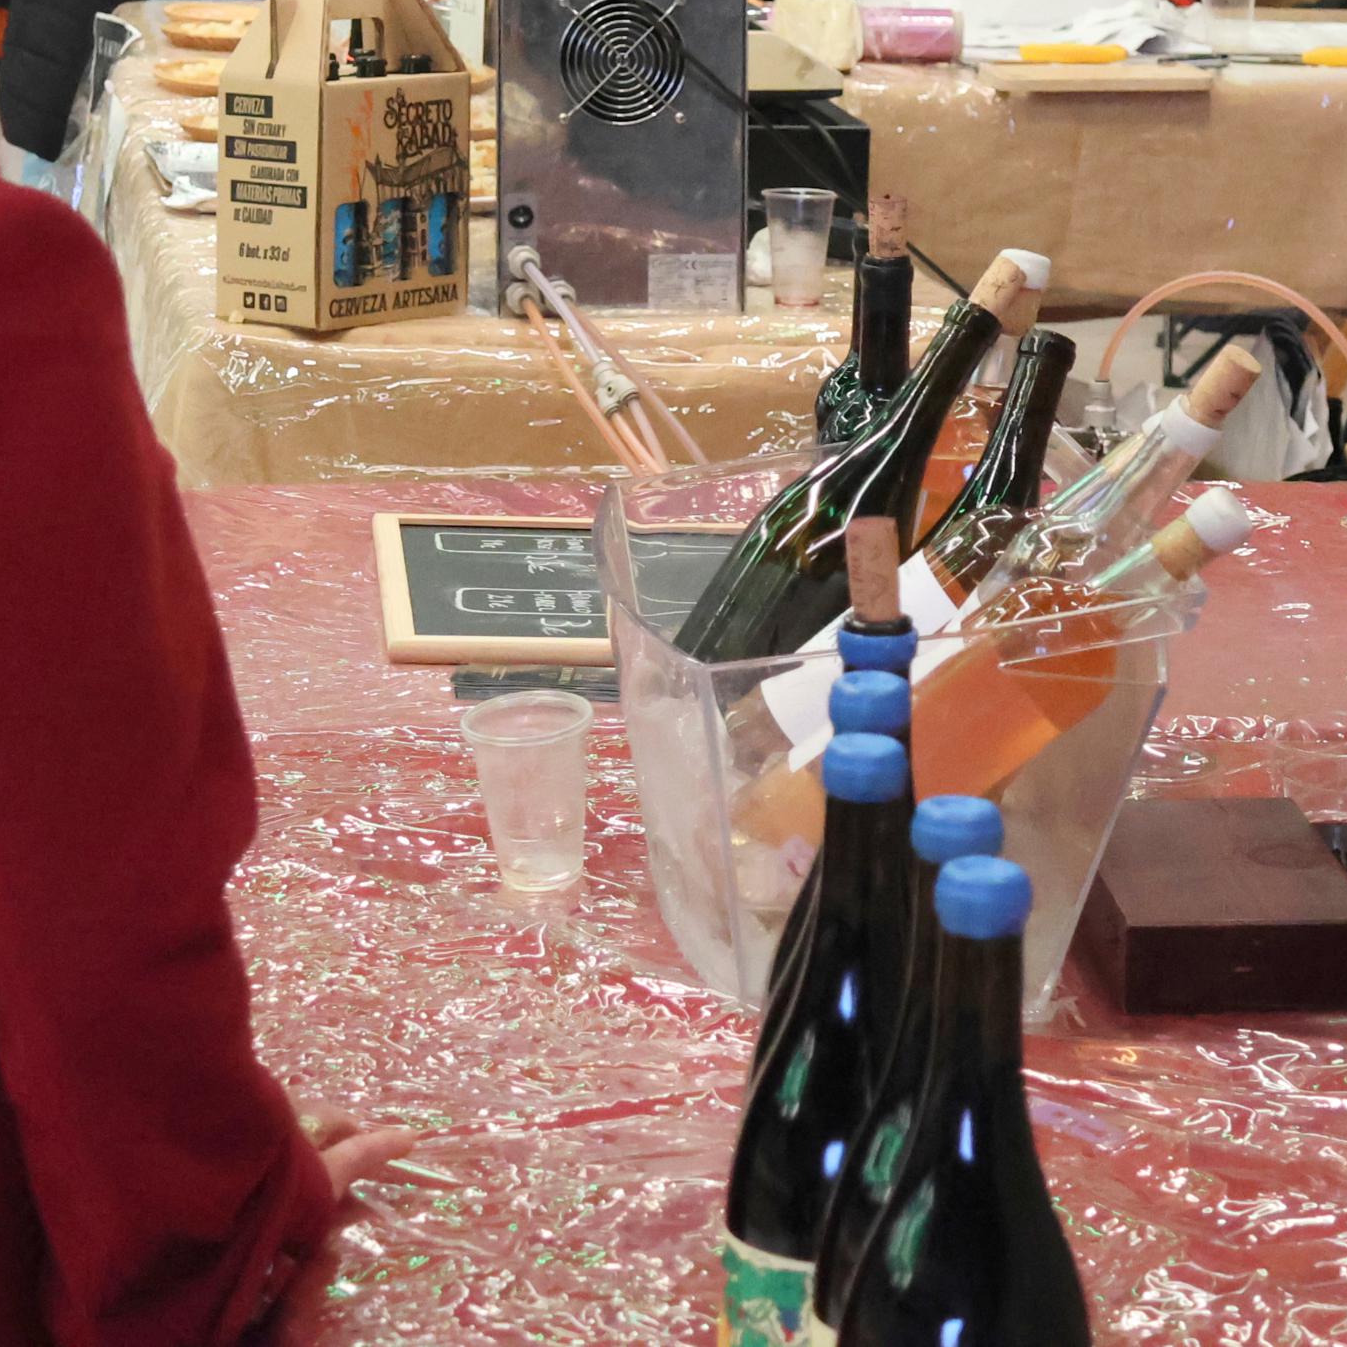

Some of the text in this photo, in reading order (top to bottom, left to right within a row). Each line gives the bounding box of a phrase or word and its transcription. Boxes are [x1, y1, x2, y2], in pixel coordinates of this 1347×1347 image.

[233, 96, 265, 115] CERVEZA
[384, 98, 453, 129] SECRETO
[244, 119, 255, 135] SIN
[243, 207, 274, 225] CALIDAD
[239, 242, 245, 258] 6
[269, 245, 282, 262] 33
[329, 283, 459, 319] CERVEZA ARTESANA
